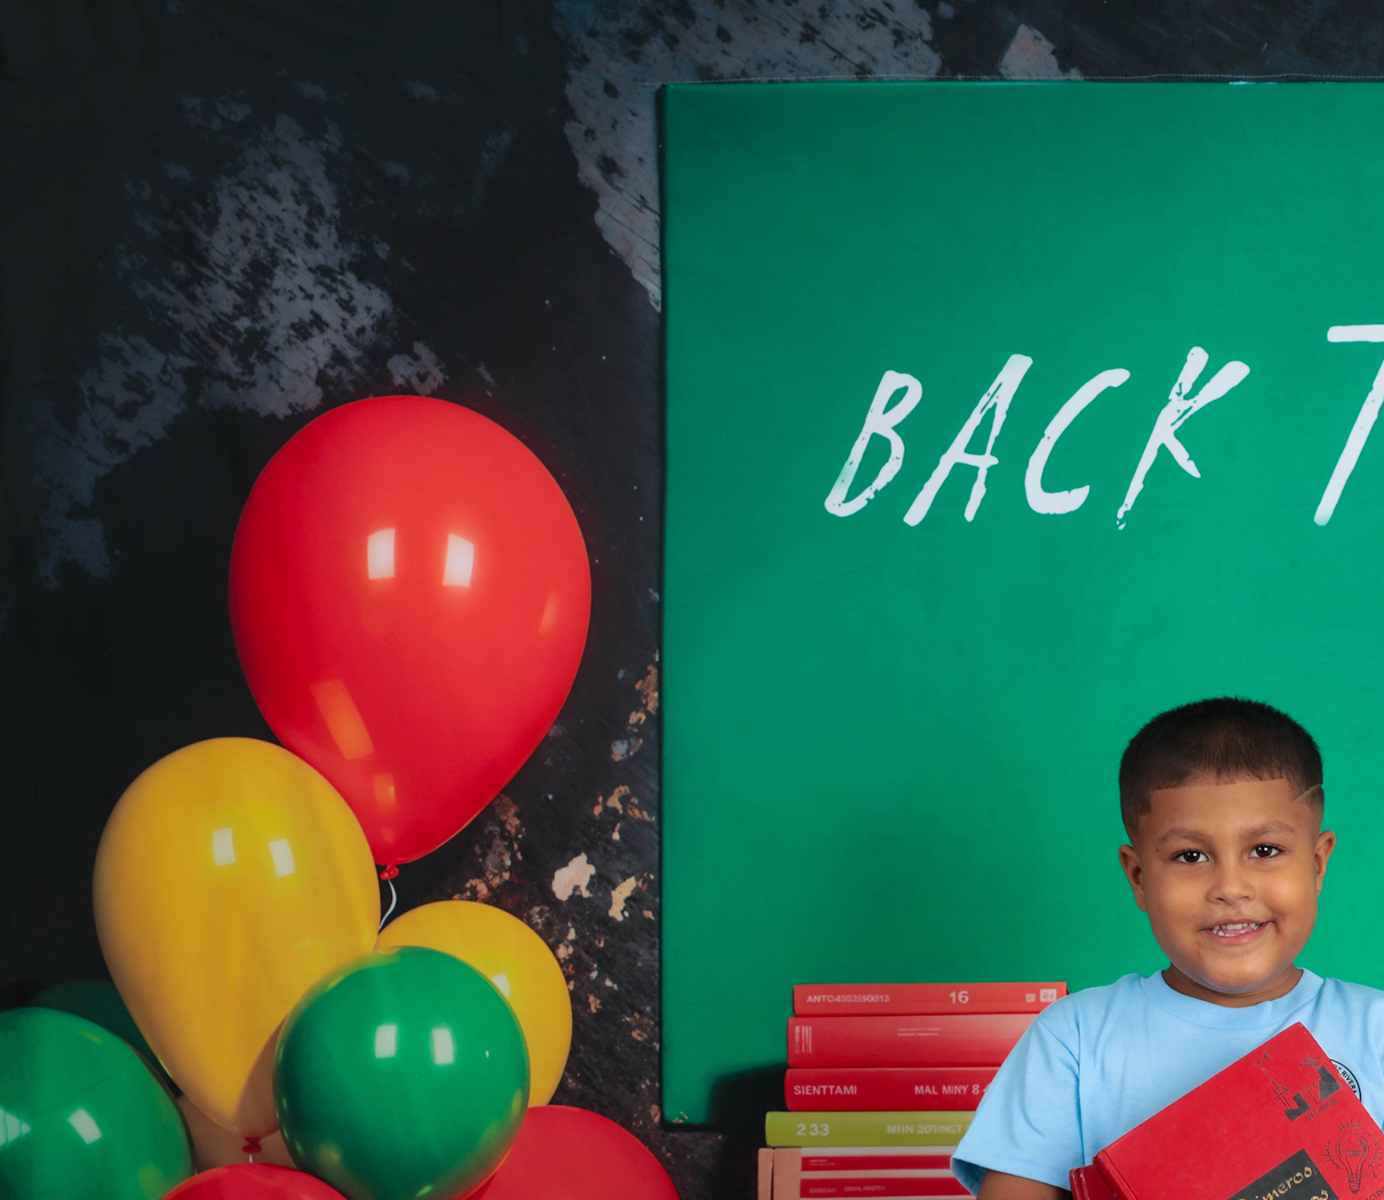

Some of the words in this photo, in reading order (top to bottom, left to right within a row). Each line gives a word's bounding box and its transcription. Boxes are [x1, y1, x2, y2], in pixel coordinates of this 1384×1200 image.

[824, 346, 1250, 527] BACK
[949, 990, 969, 1004] 16
[914, 1084, 938, 1095] MAL
